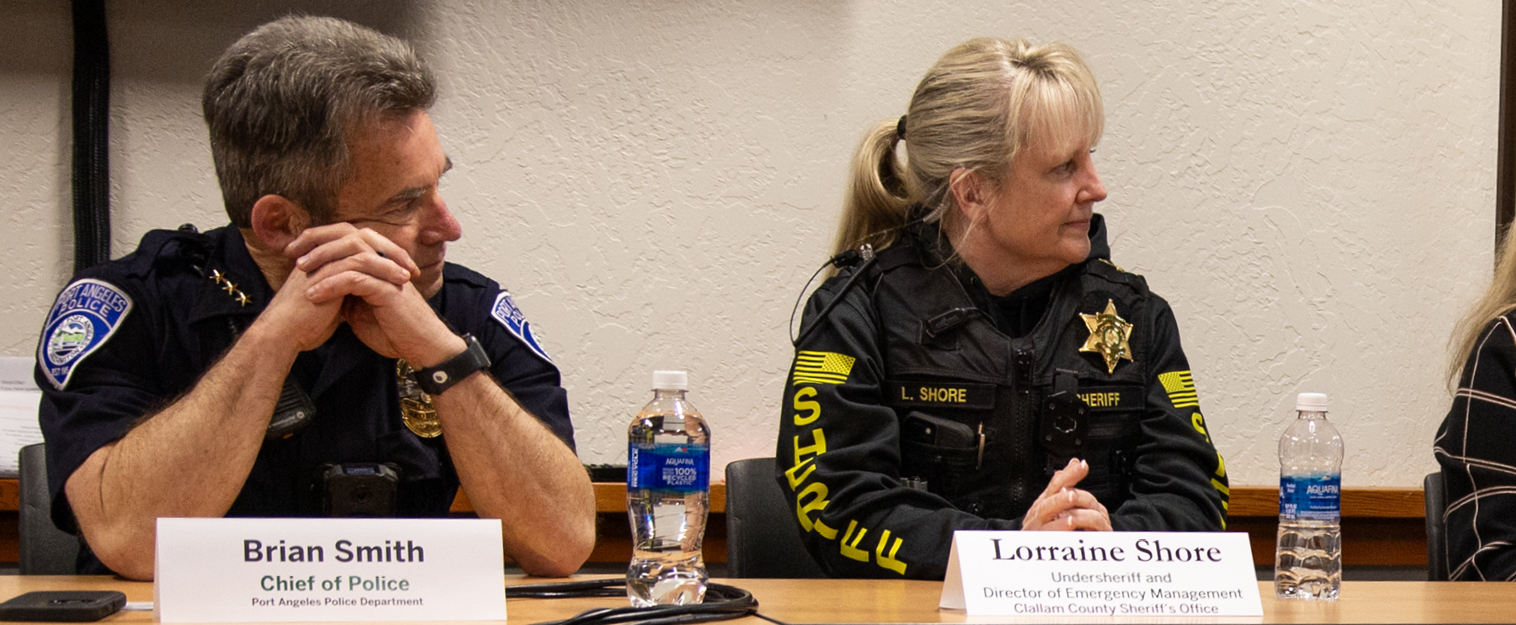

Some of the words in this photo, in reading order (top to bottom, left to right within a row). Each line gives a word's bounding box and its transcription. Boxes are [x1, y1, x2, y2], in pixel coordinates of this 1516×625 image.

[81, 284, 126, 312] ANGELES
[58, 298, 112, 317] POLICE
[902, 387, 914, 400] L.
[919, 387, 967, 403] SHORE
[674, 467, 697, 476] 100%
[243, 539, 324, 563] Brian
[334, 539, 425, 563] Smith
[990, 538, 1125, 562] Lorraine
[1136, 538, 1223, 563] Shore
[260, 575, 315, 592] Chief
[321, 575, 343, 592] of
[348, 575, 410, 592] Police
[1050, 571, 1142, 583] Undersheriff
[1145, 572, 1172, 583] and
[982, 586, 1043, 599] Director
[1047, 587, 1062, 599] of
[1066, 588, 1147, 602] Emergency
[1150, 588, 1244, 602] Management
[251, 597, 275, 607] Port
[278, 597, 322, 609] Angeles
[324, 597, 357, 607] Police
[360, 597, 424, 609] Department
[1013, 602, 1065, 614] Clallam
[1068, 603, 1117, 616] County
[1120, 603, 1177, 614] Sheriff's
[1180, 603, 1219, 614] Office
